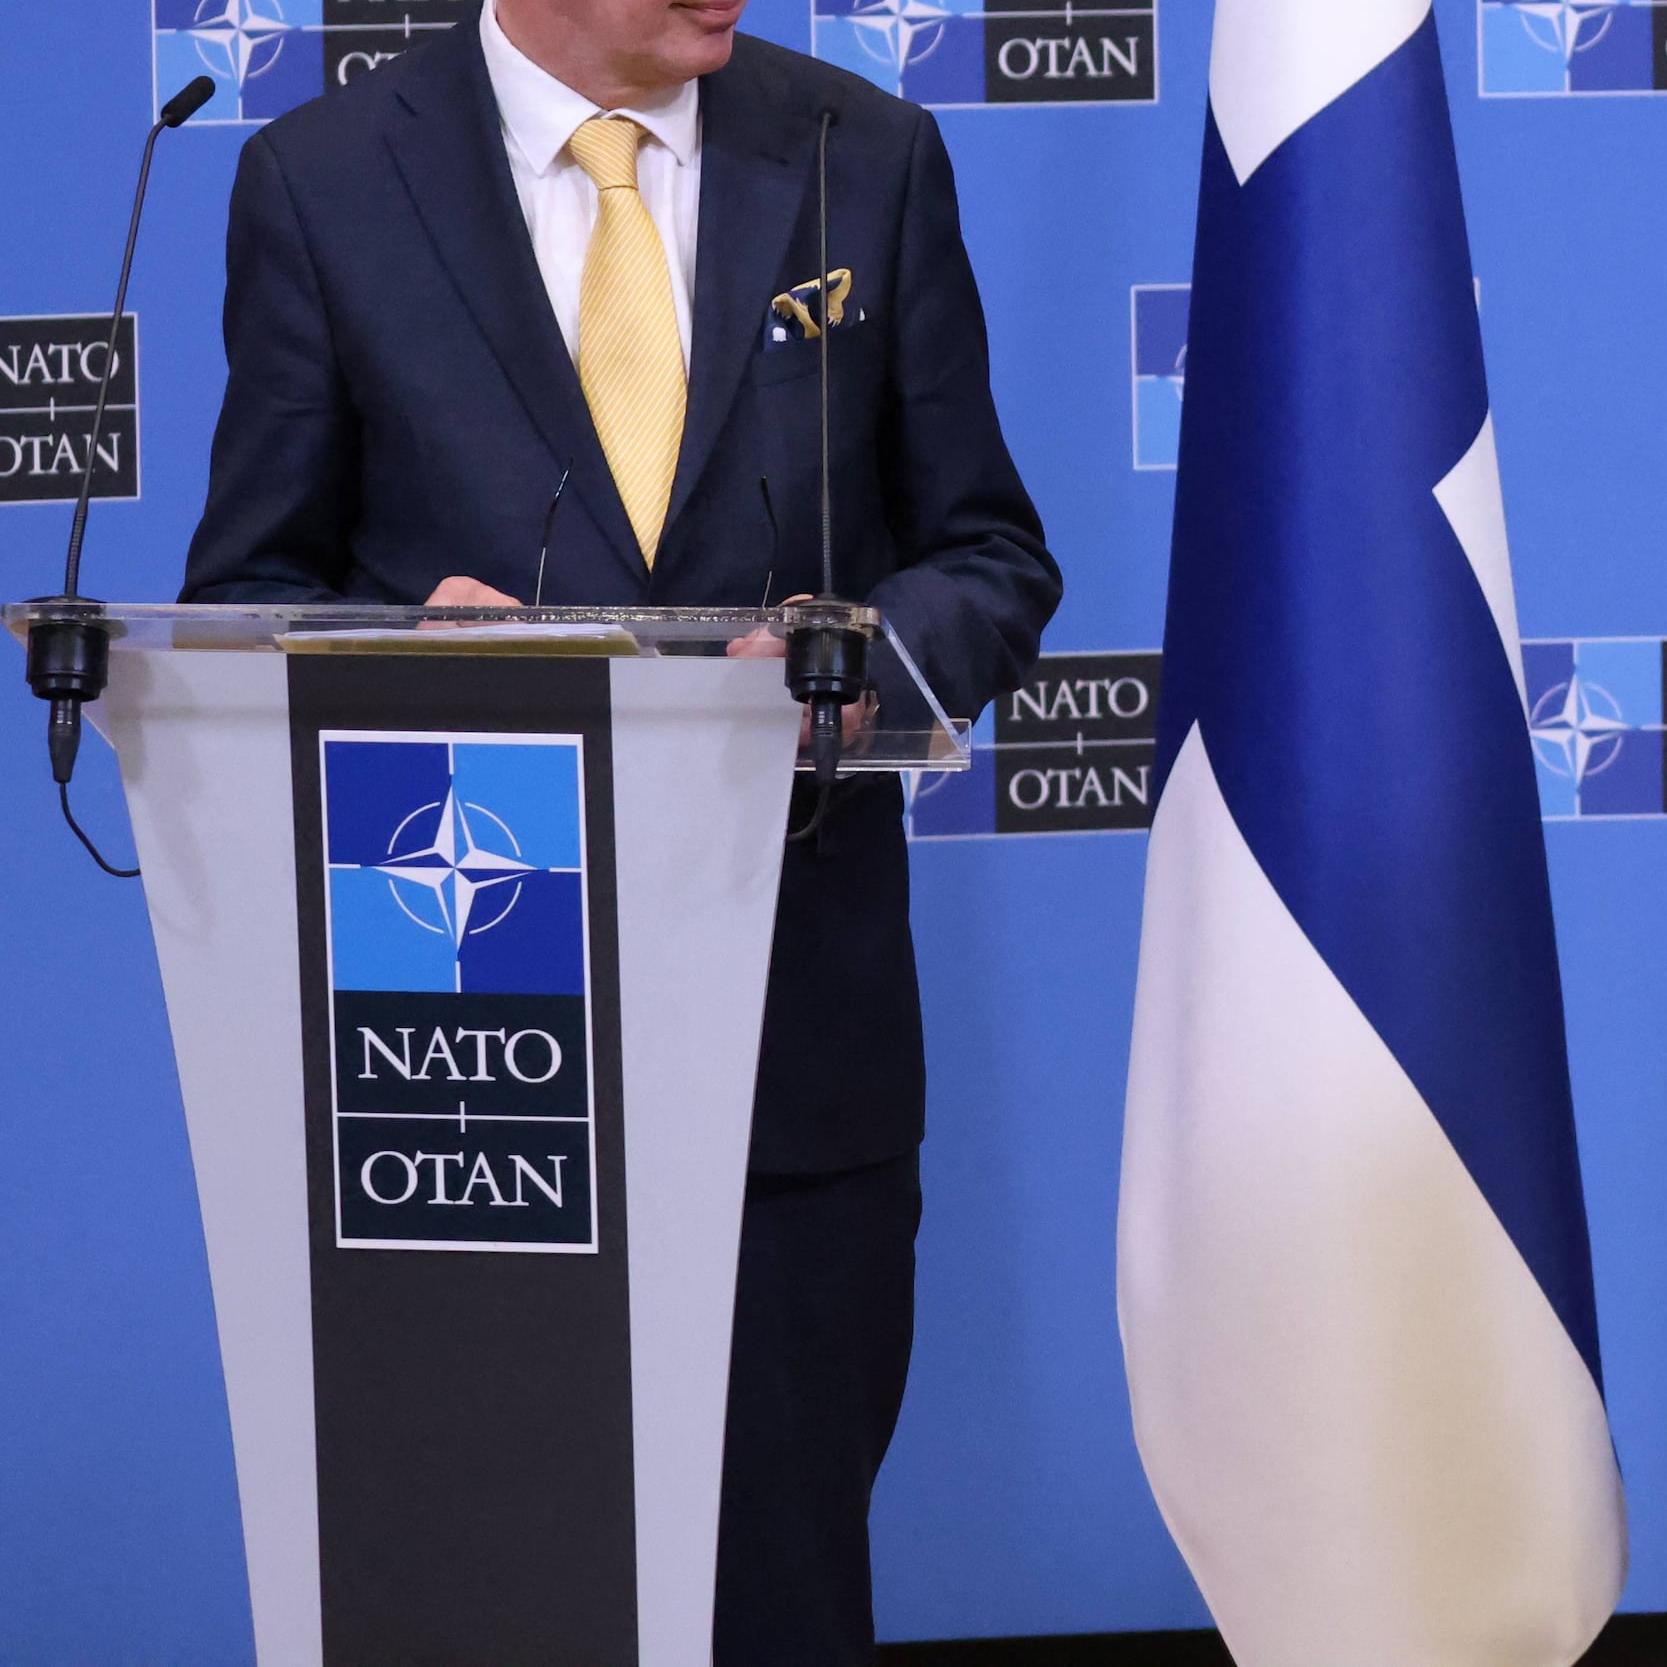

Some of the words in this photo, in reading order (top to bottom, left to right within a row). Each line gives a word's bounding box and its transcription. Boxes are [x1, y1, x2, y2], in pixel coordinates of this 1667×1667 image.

[998, 37, 1139, 79] OTAN
[1009, 677, 1149, 721] NATO
[1009, 765, 1150, 810] OTAN
[356, 1026, 562, 1083] NATO
[360, 1149, 568, 1208] OTAN
